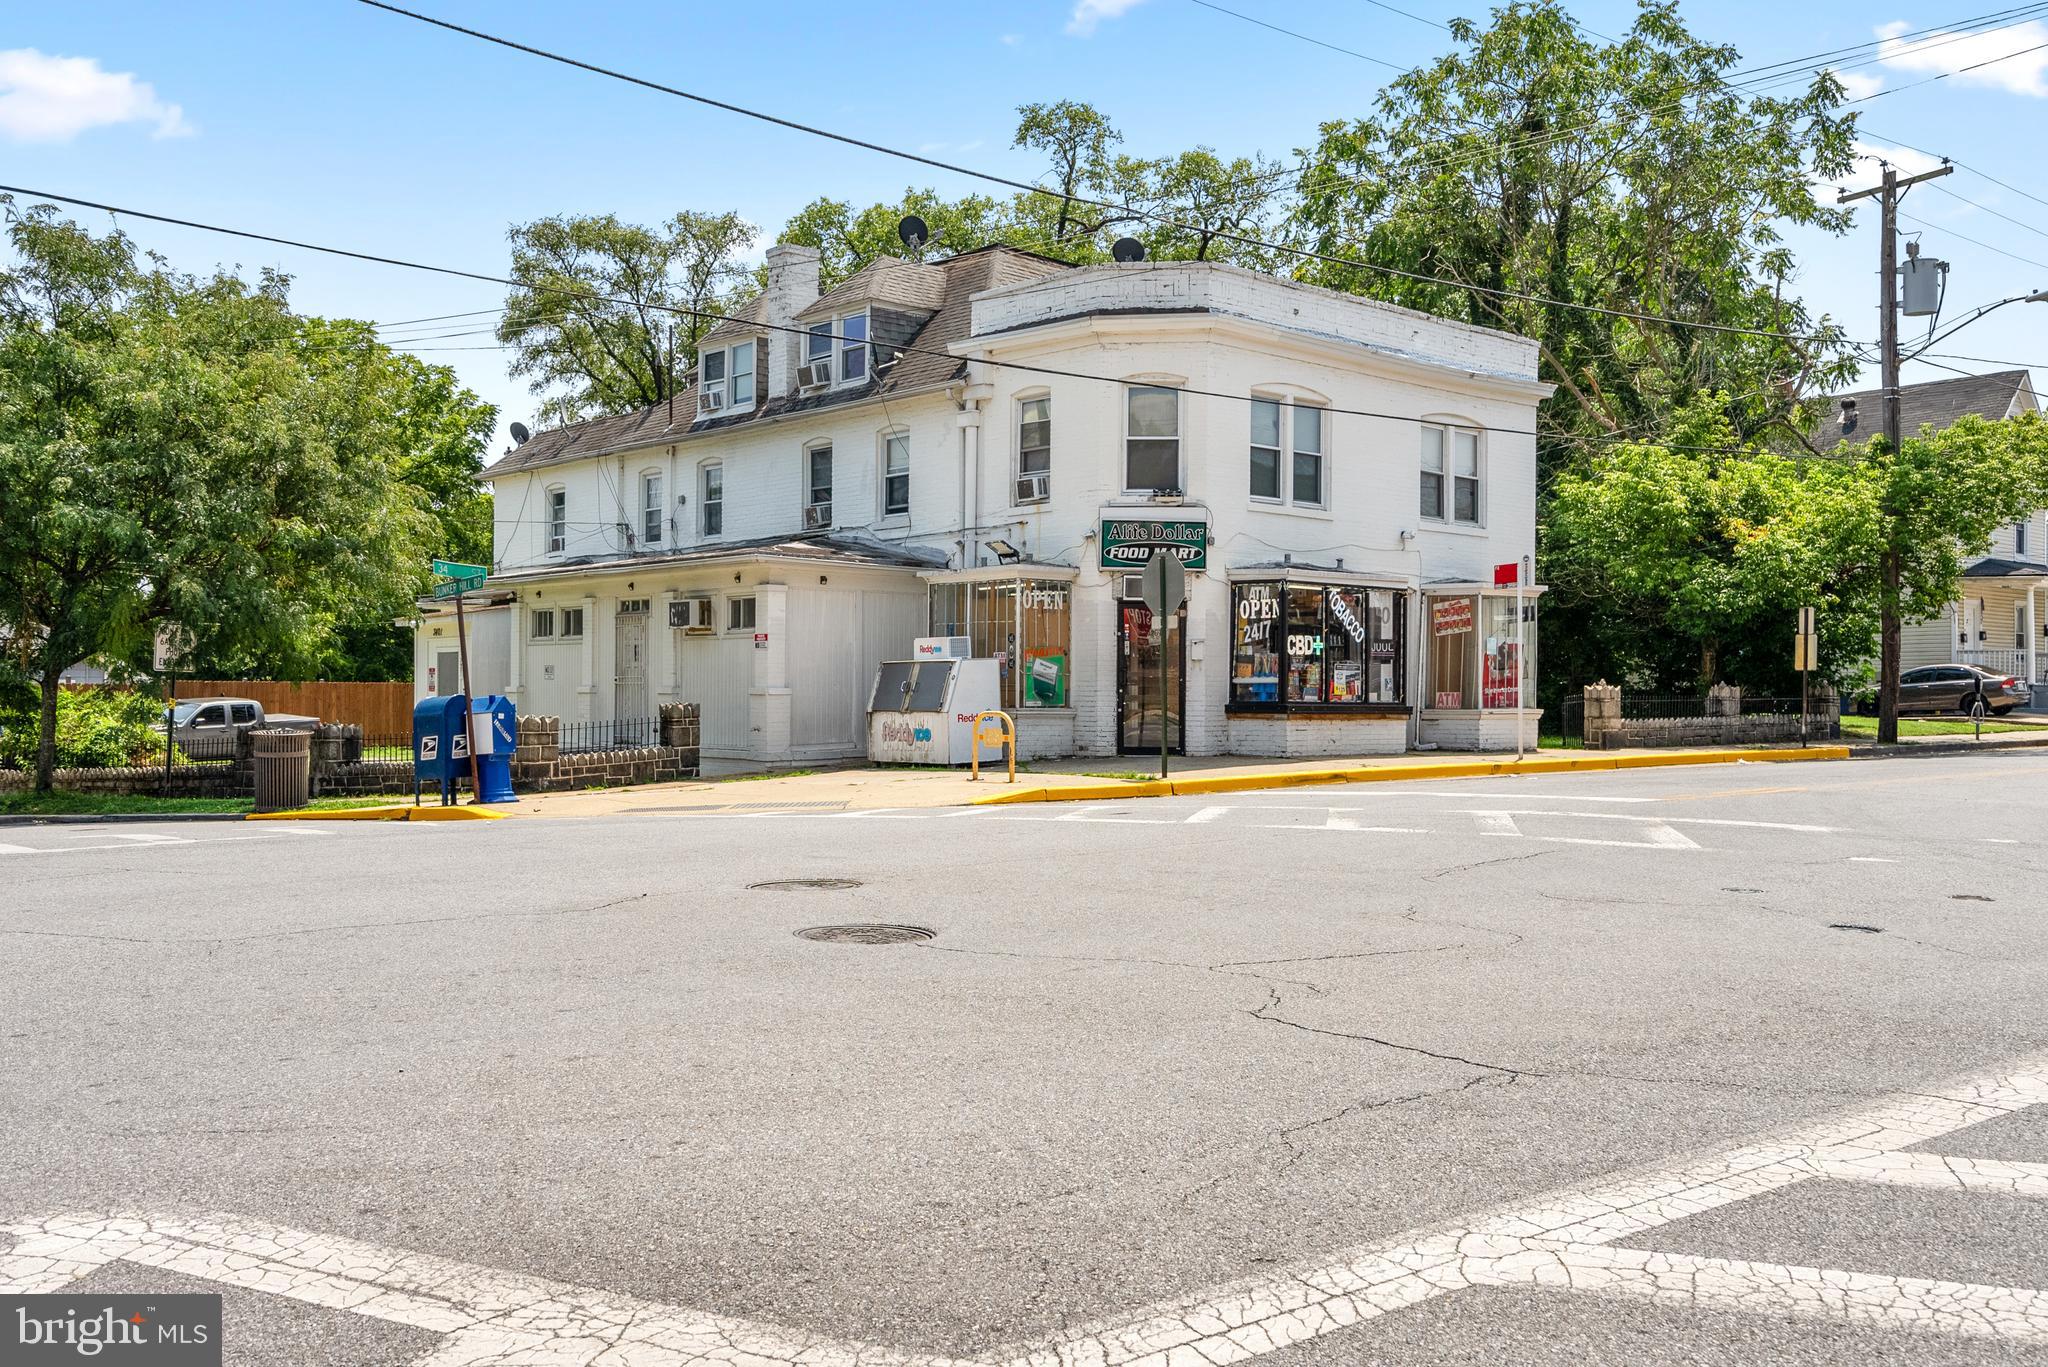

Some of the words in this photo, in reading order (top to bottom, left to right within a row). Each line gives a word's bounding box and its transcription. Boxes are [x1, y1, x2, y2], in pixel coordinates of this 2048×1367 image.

[1108, 523, 1147, 540] Alife
[1151, 523, 1204, 541] Dollar
[1109, 547, 1149, 559] FOOD
[438, 563, 448, 574] 34
[435, 583, 457, 597] BUNKER
[459, 579, 472, 592] HILL
[474, 577, 481, 589] RD
[1249, 586, 1270, 600] ATM
[1022, 589, 1064, 610] OPEN
[1240, 598, 1279, 619] OPEN
[1243, 620, 1271, 643] 24/7
[1370, 642, 1394, 652] JUUL
[1437, 693, 1460, 707] ATM
